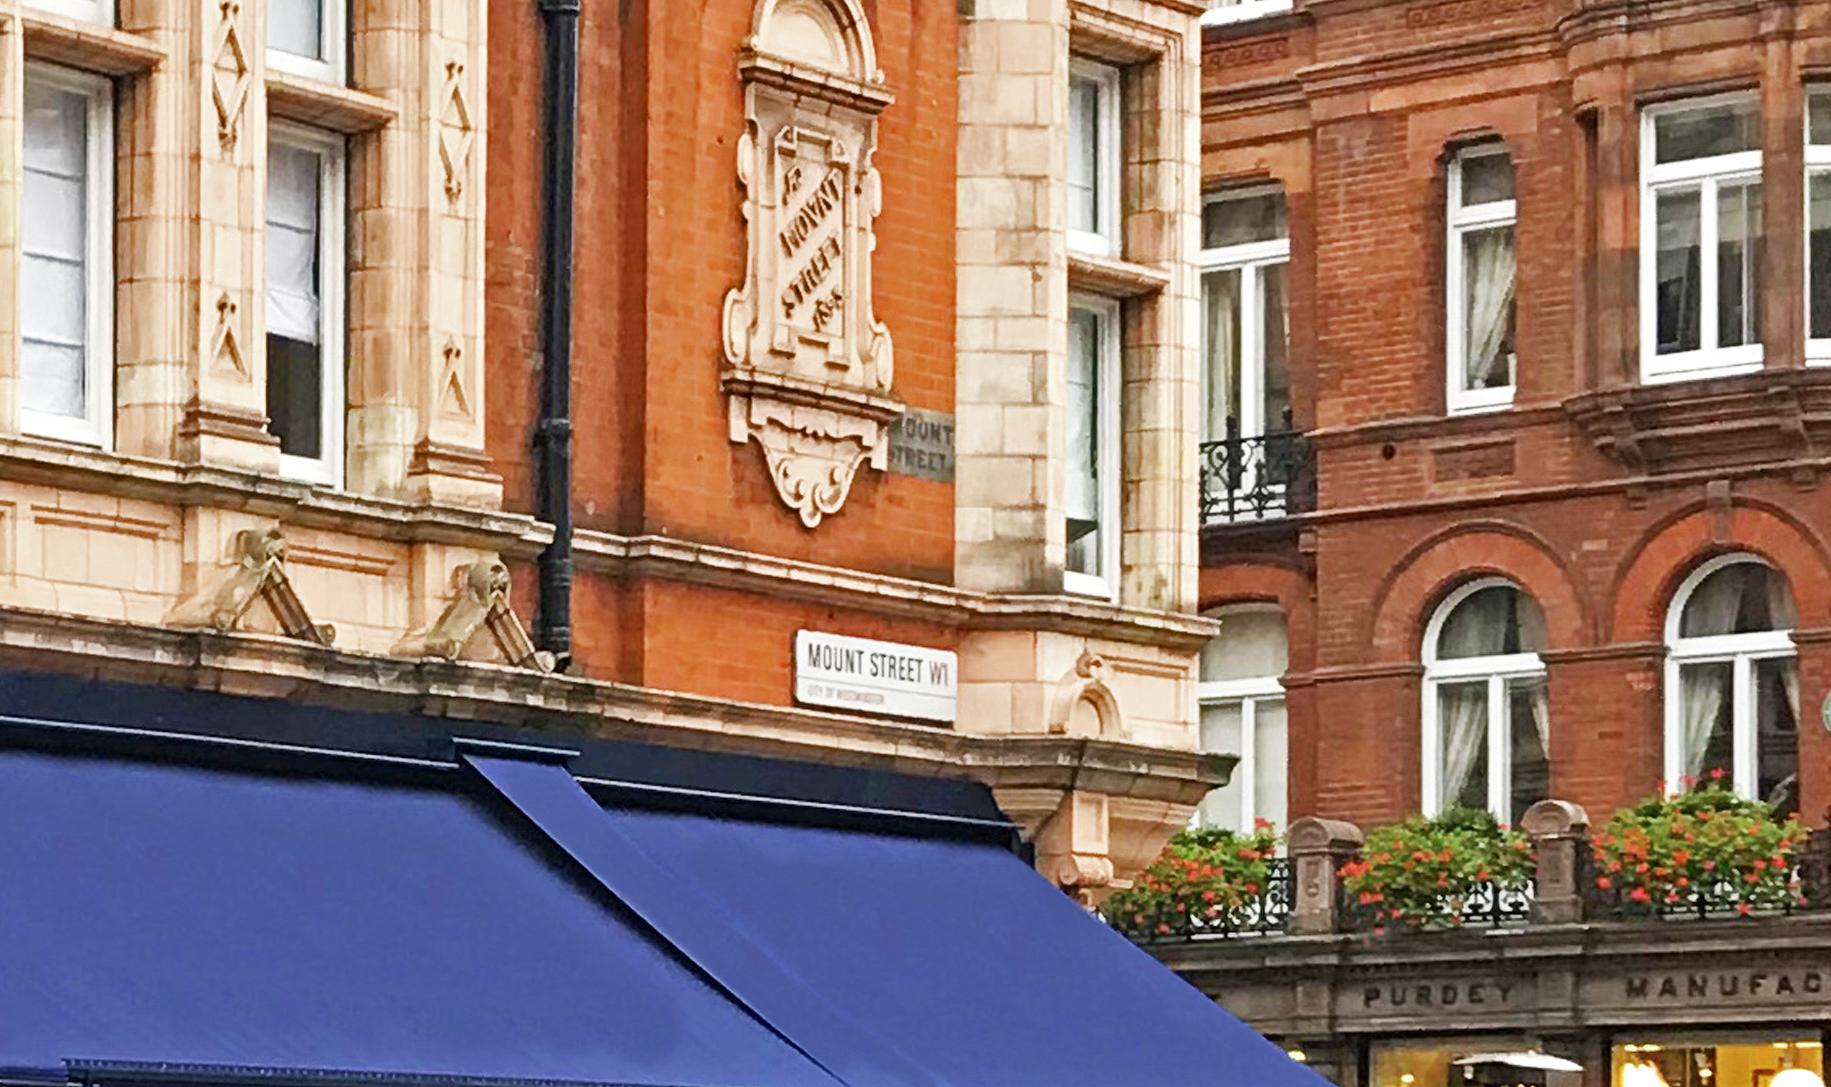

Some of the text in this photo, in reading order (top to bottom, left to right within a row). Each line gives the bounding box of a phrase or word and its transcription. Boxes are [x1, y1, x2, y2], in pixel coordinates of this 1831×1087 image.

[808, 643, 949, 687] MOUNT STREET W1
[1364, 983, 1514, 1008] PURDEY
